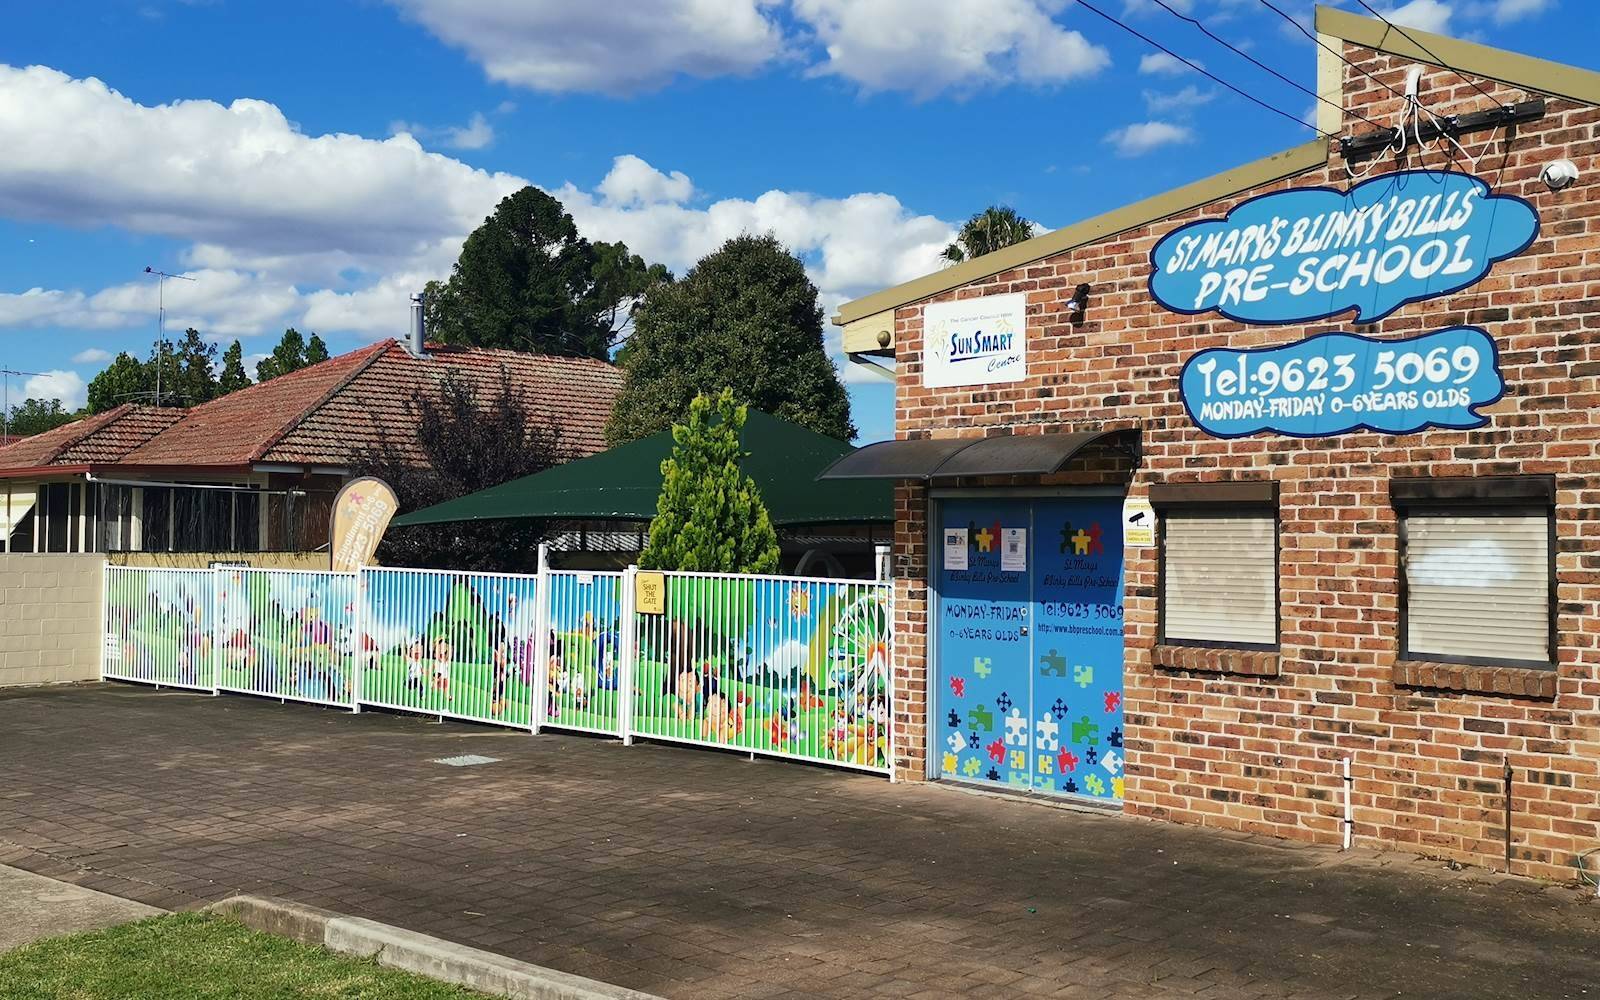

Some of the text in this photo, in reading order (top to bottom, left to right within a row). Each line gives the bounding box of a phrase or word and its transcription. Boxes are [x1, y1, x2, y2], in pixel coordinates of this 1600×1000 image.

[1194, 234, 1473, 309] PRE-SCHOOL
[987, 354, 1021, 373] Centre
[1372, 345, 1480, 390] 5069
[1199, 392, 1326, 421] MONDAY-FRIDAY
[1422, 387, 1471, 409] OLDS
[642, 583, 657, 591] SHUT
[643, 597, 657, 605] GATE
[1095, 603, 1124, 621] 5069
[994, 629, 1019, 642] OLDS
